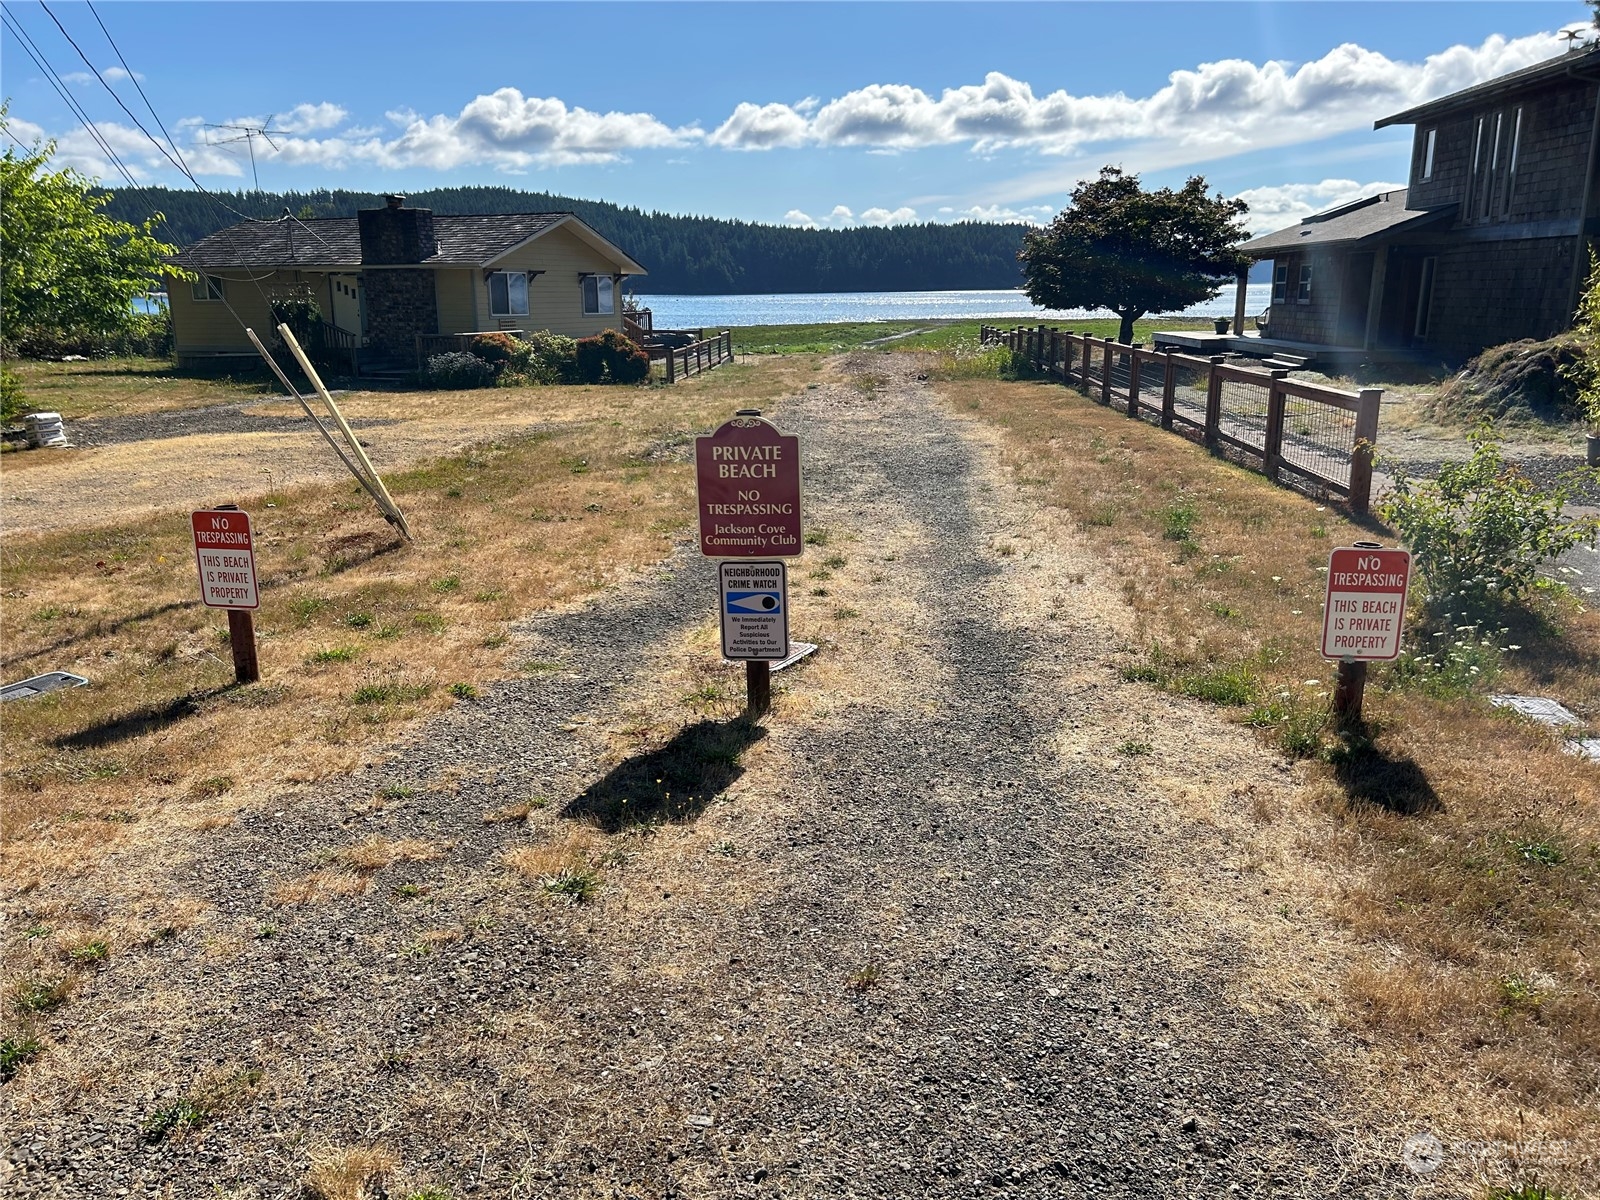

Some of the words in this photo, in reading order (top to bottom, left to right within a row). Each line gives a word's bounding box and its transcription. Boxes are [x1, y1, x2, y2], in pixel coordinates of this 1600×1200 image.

[712, 446, 782, 460] PRIVATE
[719, 463, 776, 478] BEACH
[738, 490, 760, 501] NO
[707, 503, 792, 515] TRESPASSING
[211, 518, 229, 530] NO
[714, 523, 755, 535] Jackson
[758, 524, 786, 534] Cove
[197, 532, 248, 544] TRESPASSING
[705, 535, 767, 548] Community
[771, 534, 797, 545] Club
[202, 556, 220, 567] THIS
[224, 556, 249, 568] BEACH
[1358, 558, 1380, 570] NO
[206, 572, 215, 582] IS
[218, 572, 249, 584] PRIVATE
[724, 568, 780, 577] NEIGHBORHOOD
[728, 580, 751, 588] CRIME
[752, 580, 777, 588] WATCH
[1334, 572, 1404, 586] TRESPASSING
[210, 586, 249, 599] PROPERTY
[1334, 600, 1358, 612] THIS
[1362, 600, 1396, 614] BEACH
[1334, 618, 1344, 630] IS
[1349, 618, 1392, 632] PRIVATE
[1334, 636, 1388, 648] PROPERTY
